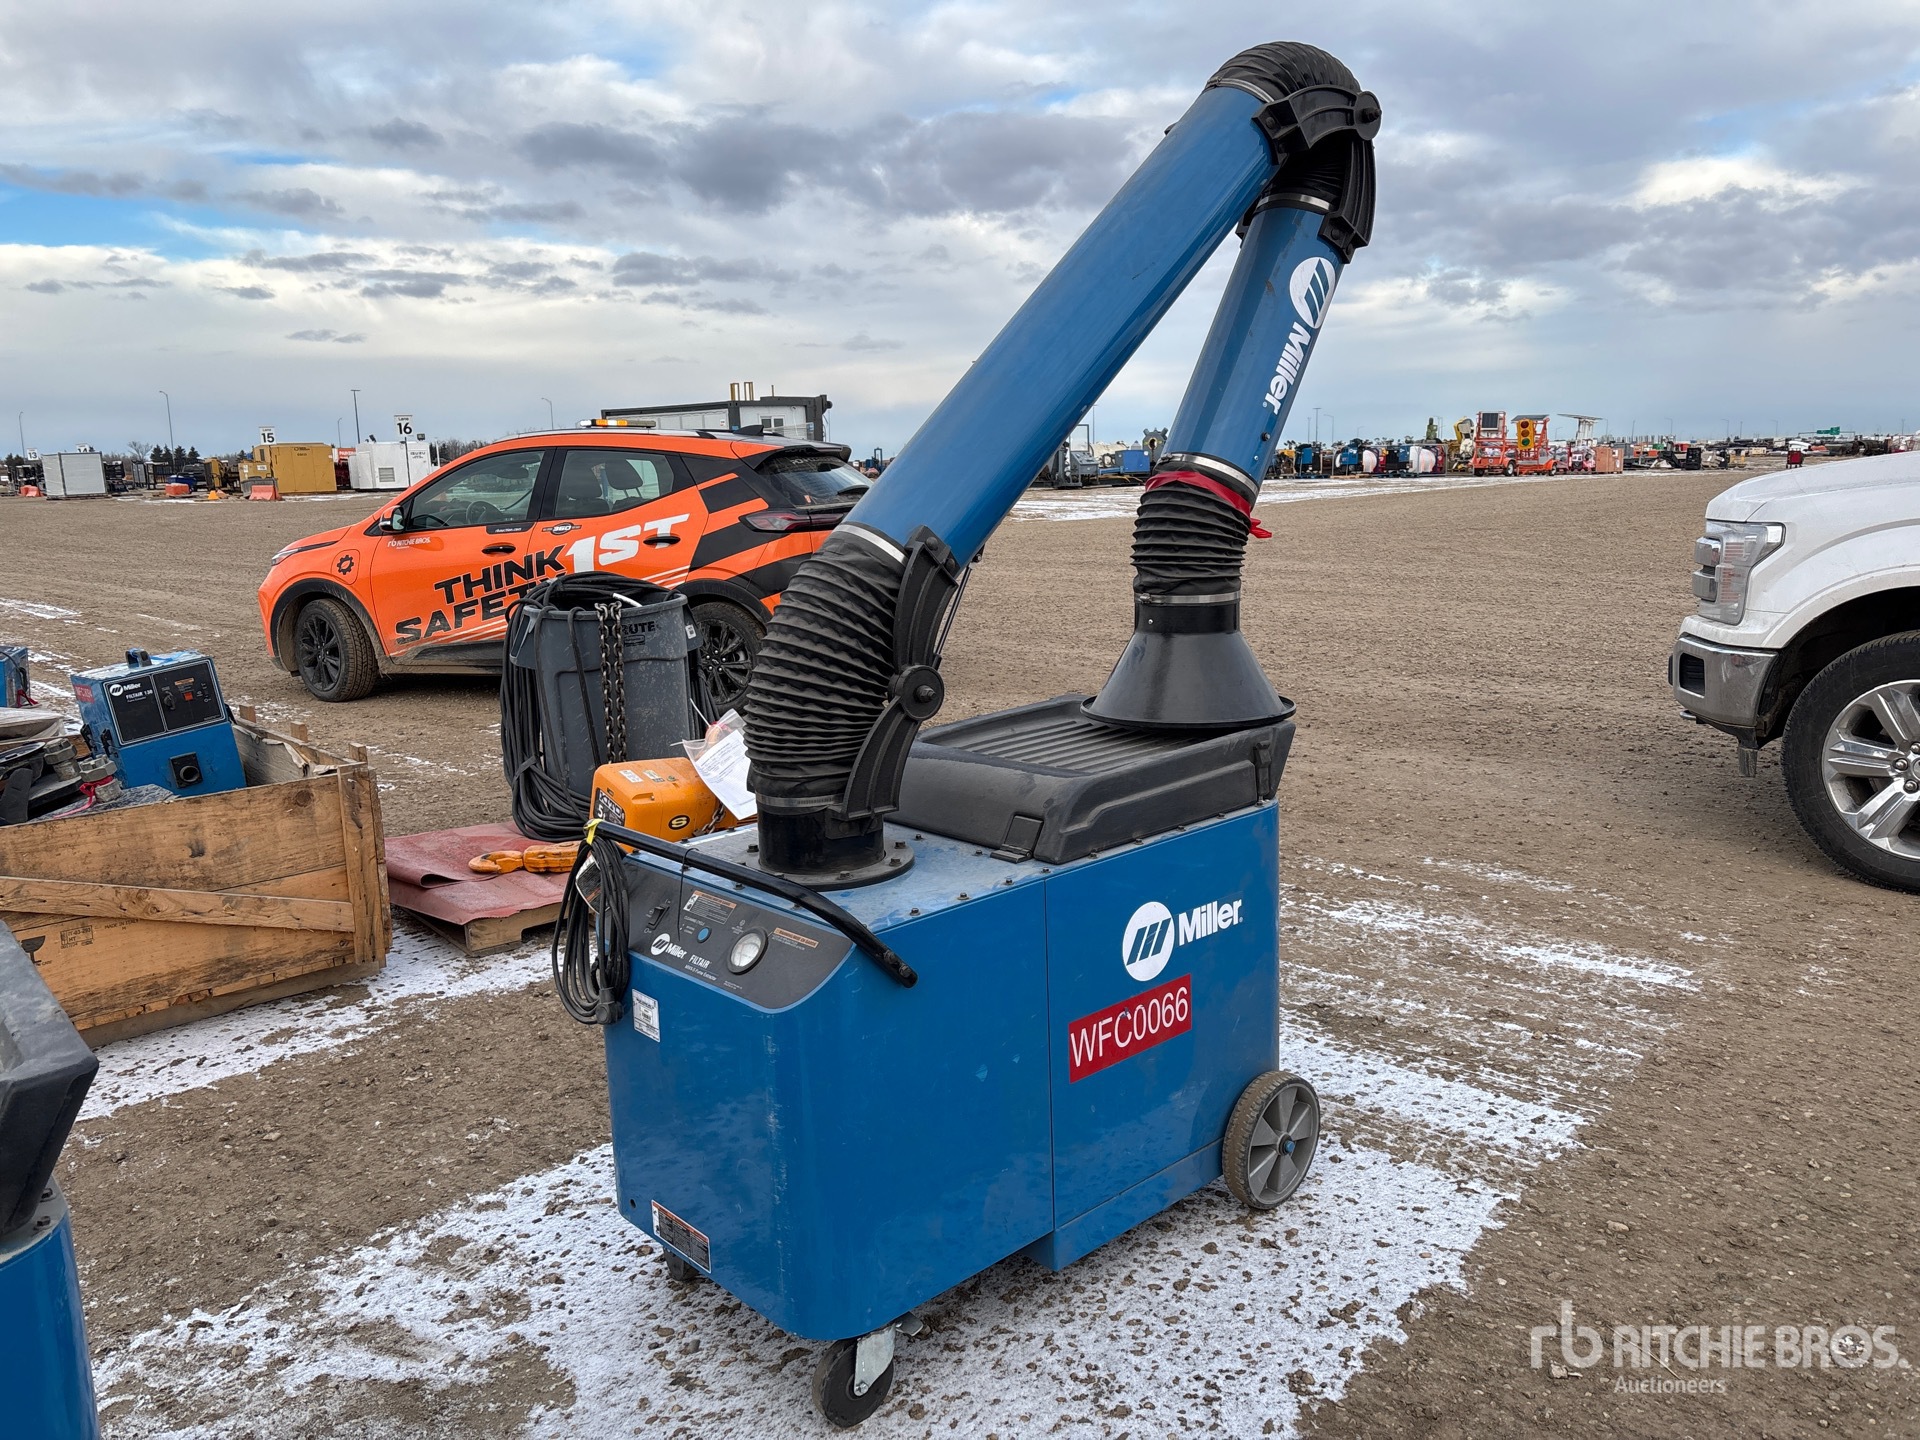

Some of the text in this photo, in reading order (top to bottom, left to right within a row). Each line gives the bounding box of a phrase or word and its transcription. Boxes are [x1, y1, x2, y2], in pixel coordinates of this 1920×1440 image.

[1264, 321, 1312, 416] Miller
[261, 432, 275, 443] 15
[397, 422, 413, 435] 16
[28, 451, 38, 459] 13
[552, 524, 572, 532] 360
[565, 513, 690, 573] 1ST
[434, 545, 567, 604] THINK
[395, 572, 566, 645] SAFET
[123, 682, 142, 691] Miller
[1178, 899, 1242, 946] Miller
[665, 942, 688, 960] Miller
[688, 954, 711, 969] FILTAIR
[1069, 986, 1189, 1068] WFC0066
